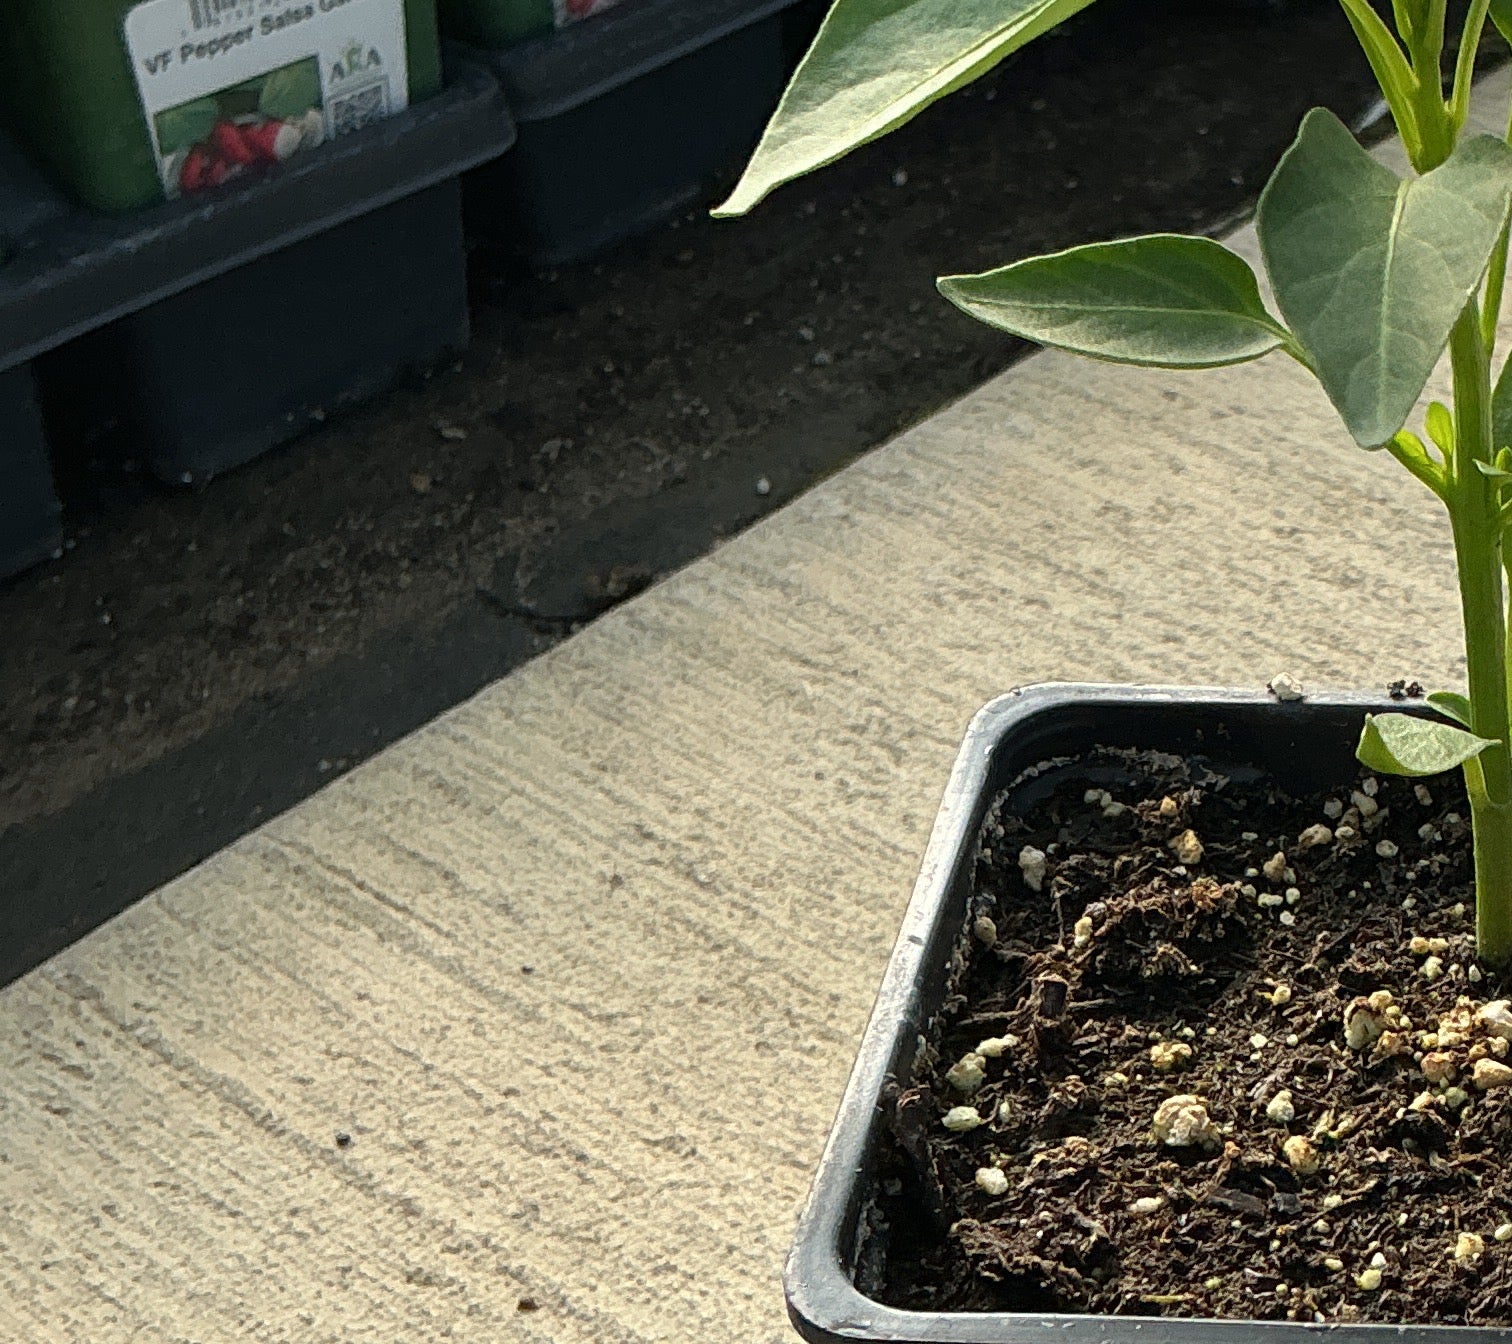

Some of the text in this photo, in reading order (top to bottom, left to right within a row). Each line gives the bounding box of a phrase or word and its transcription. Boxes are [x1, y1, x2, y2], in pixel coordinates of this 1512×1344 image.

[143, 49, 172, 76] VF
[180, 25, 253, 65] Pepper
[260, 5, 315, 36] Salsa
